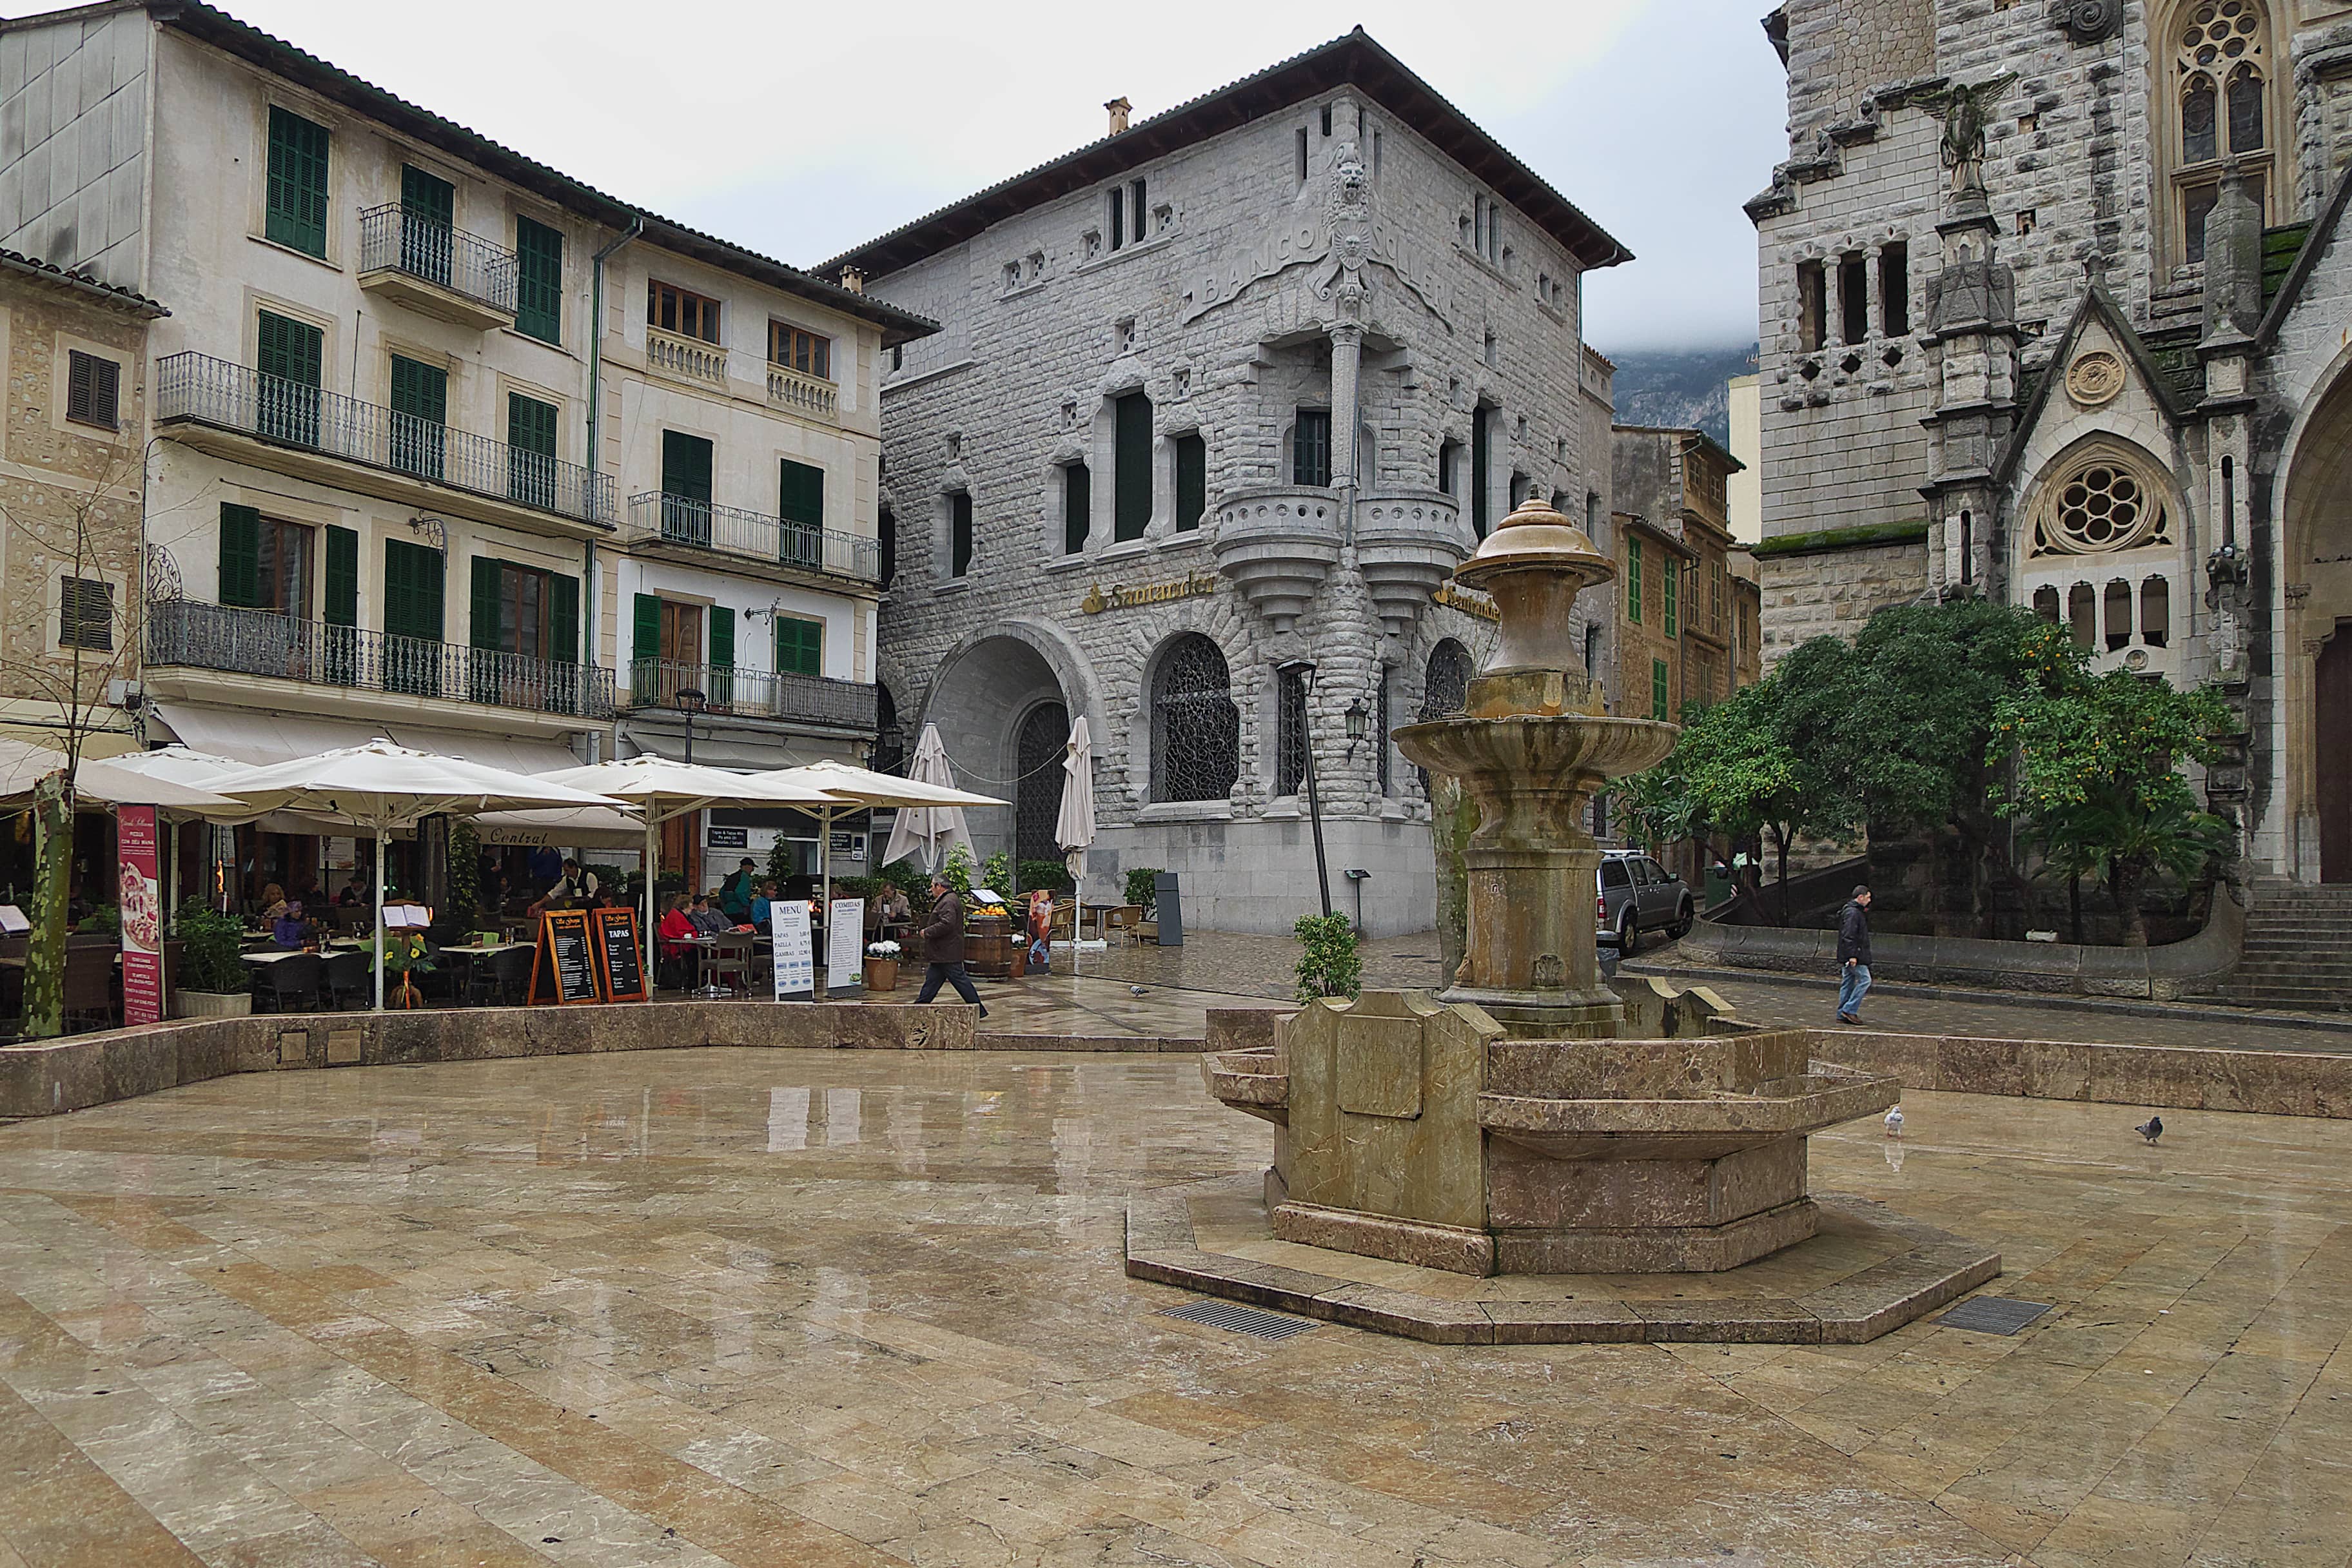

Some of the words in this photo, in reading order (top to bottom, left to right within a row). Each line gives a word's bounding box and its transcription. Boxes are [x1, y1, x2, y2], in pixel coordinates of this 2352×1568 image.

[1112, 570, 1216, 608] Santander
[1448, 585, 1502, 621] Santande
[490, 827, 548, 845] Central
[779, 904, 801, 915] MENÚ
[609, 930, 629, 938] TAPAS
